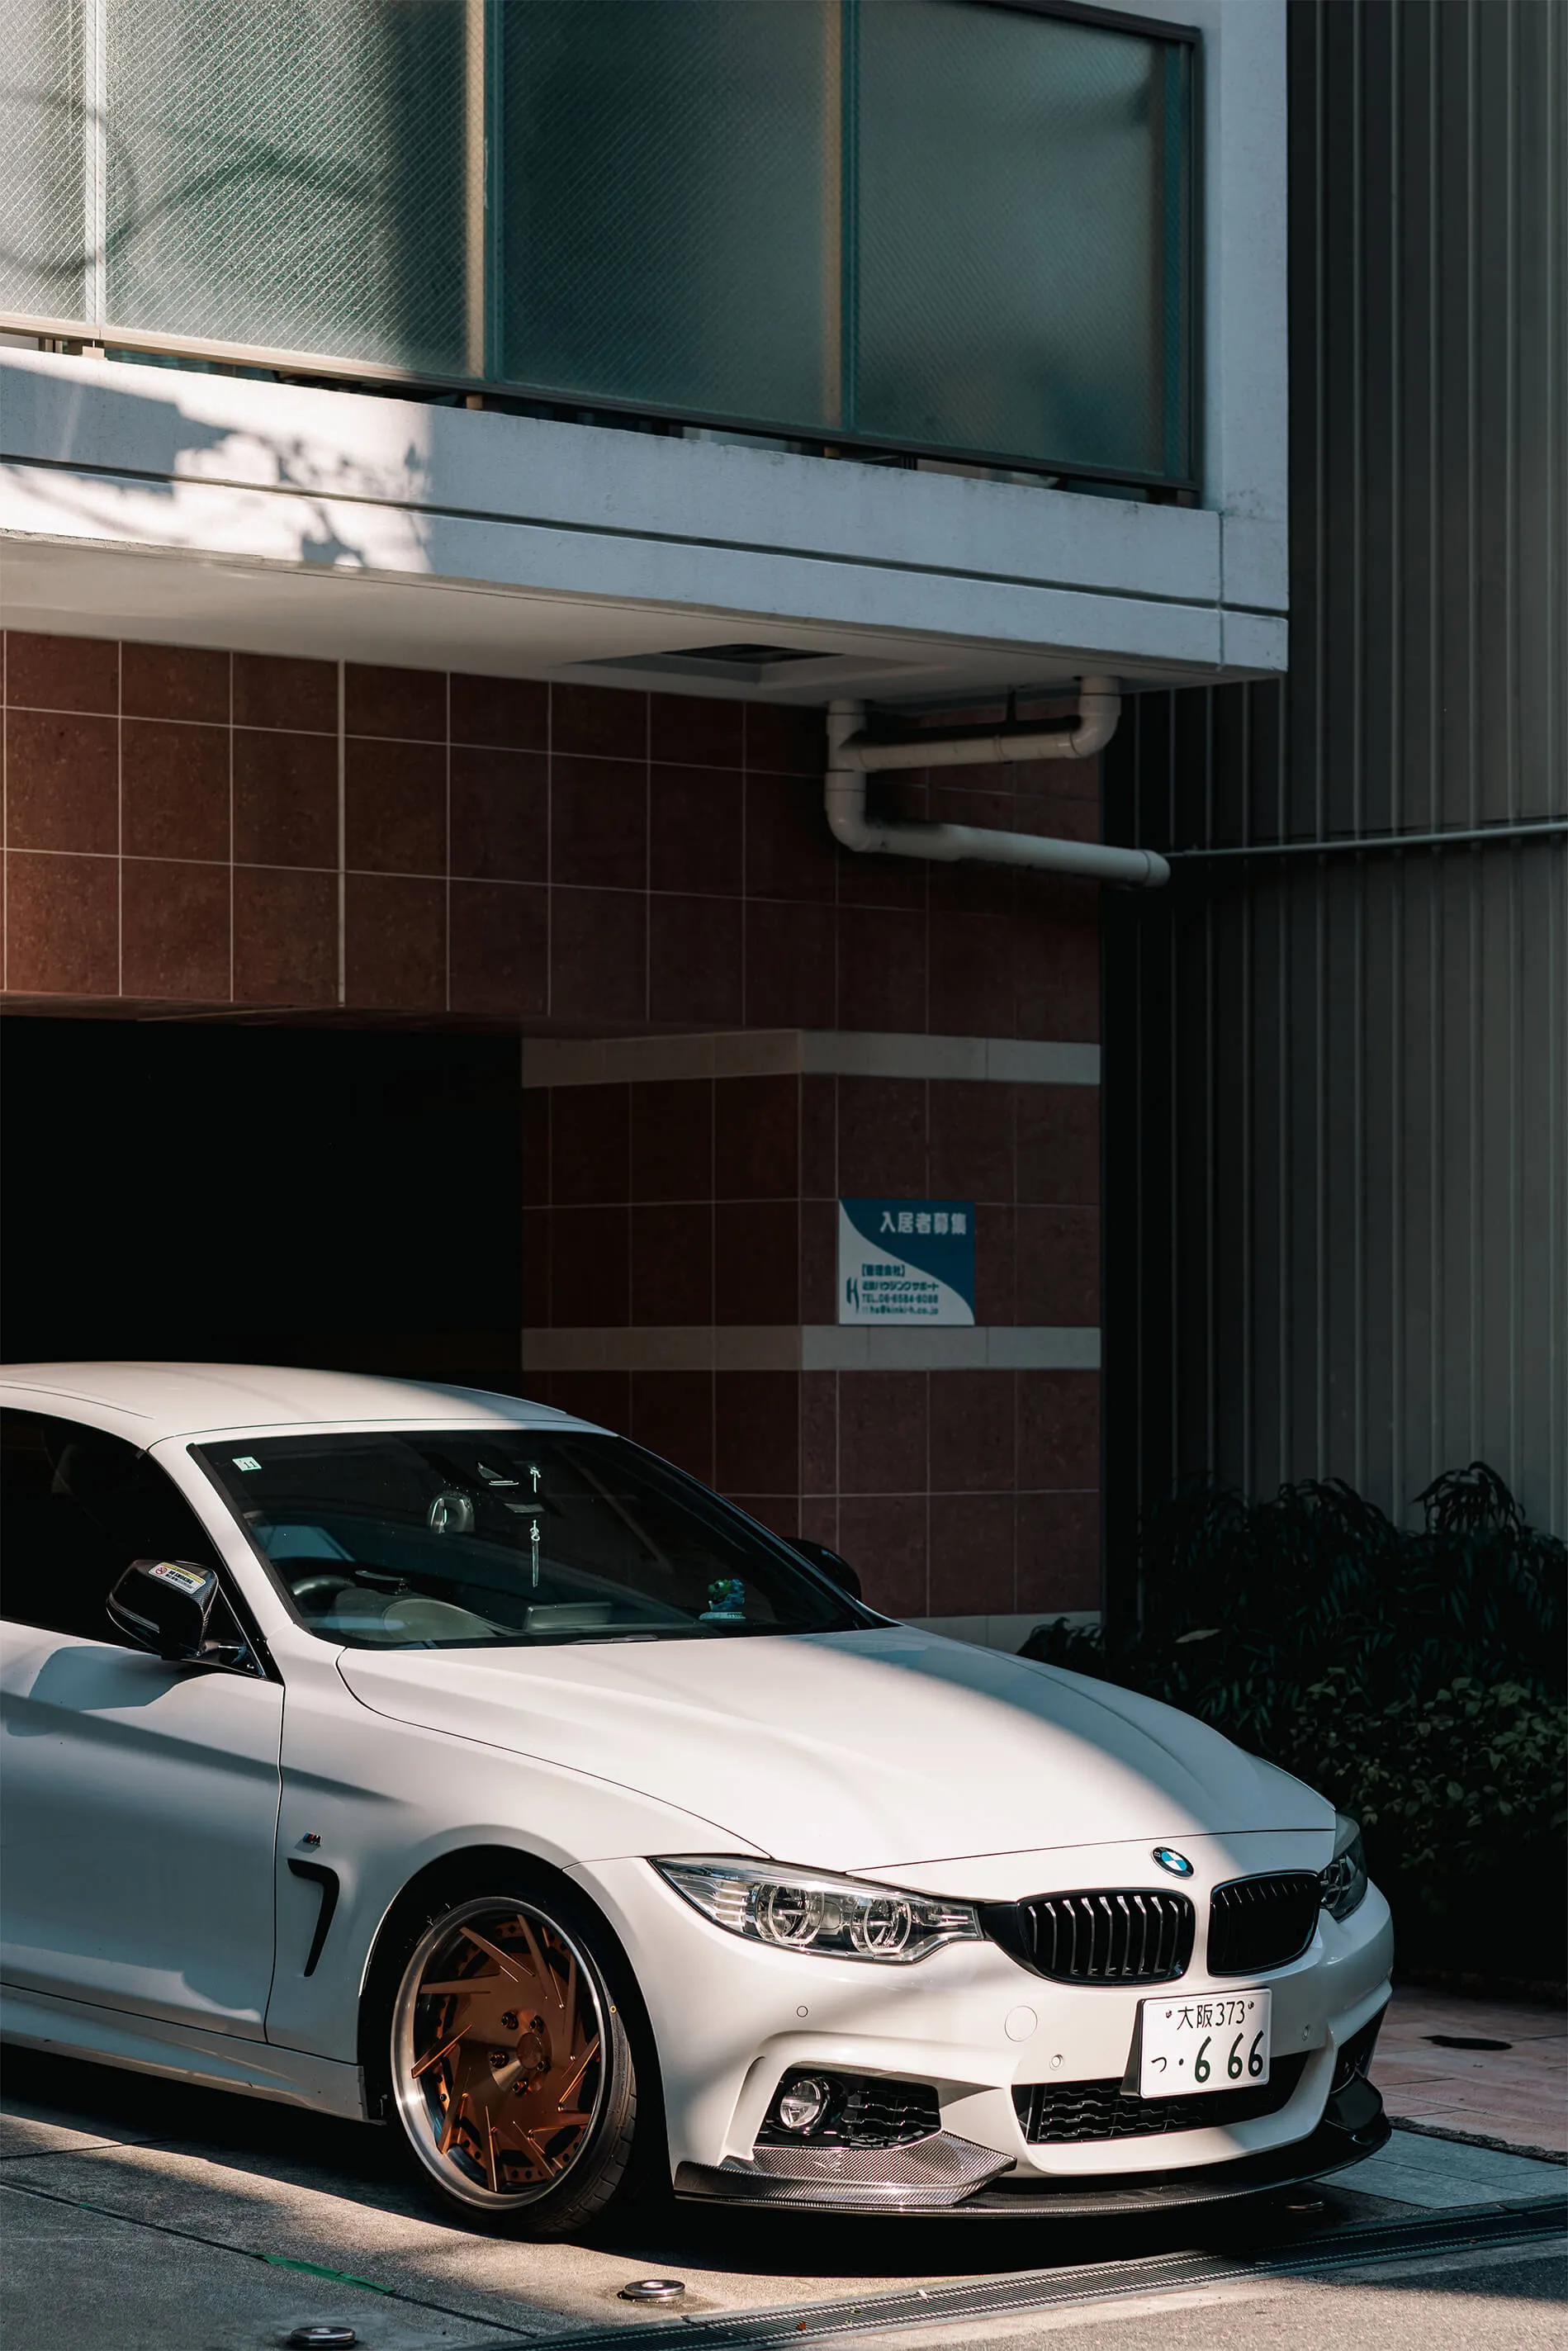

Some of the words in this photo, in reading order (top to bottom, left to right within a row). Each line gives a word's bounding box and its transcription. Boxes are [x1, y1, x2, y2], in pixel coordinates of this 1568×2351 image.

[879, 1211, 967, 1235] 入居者募集
